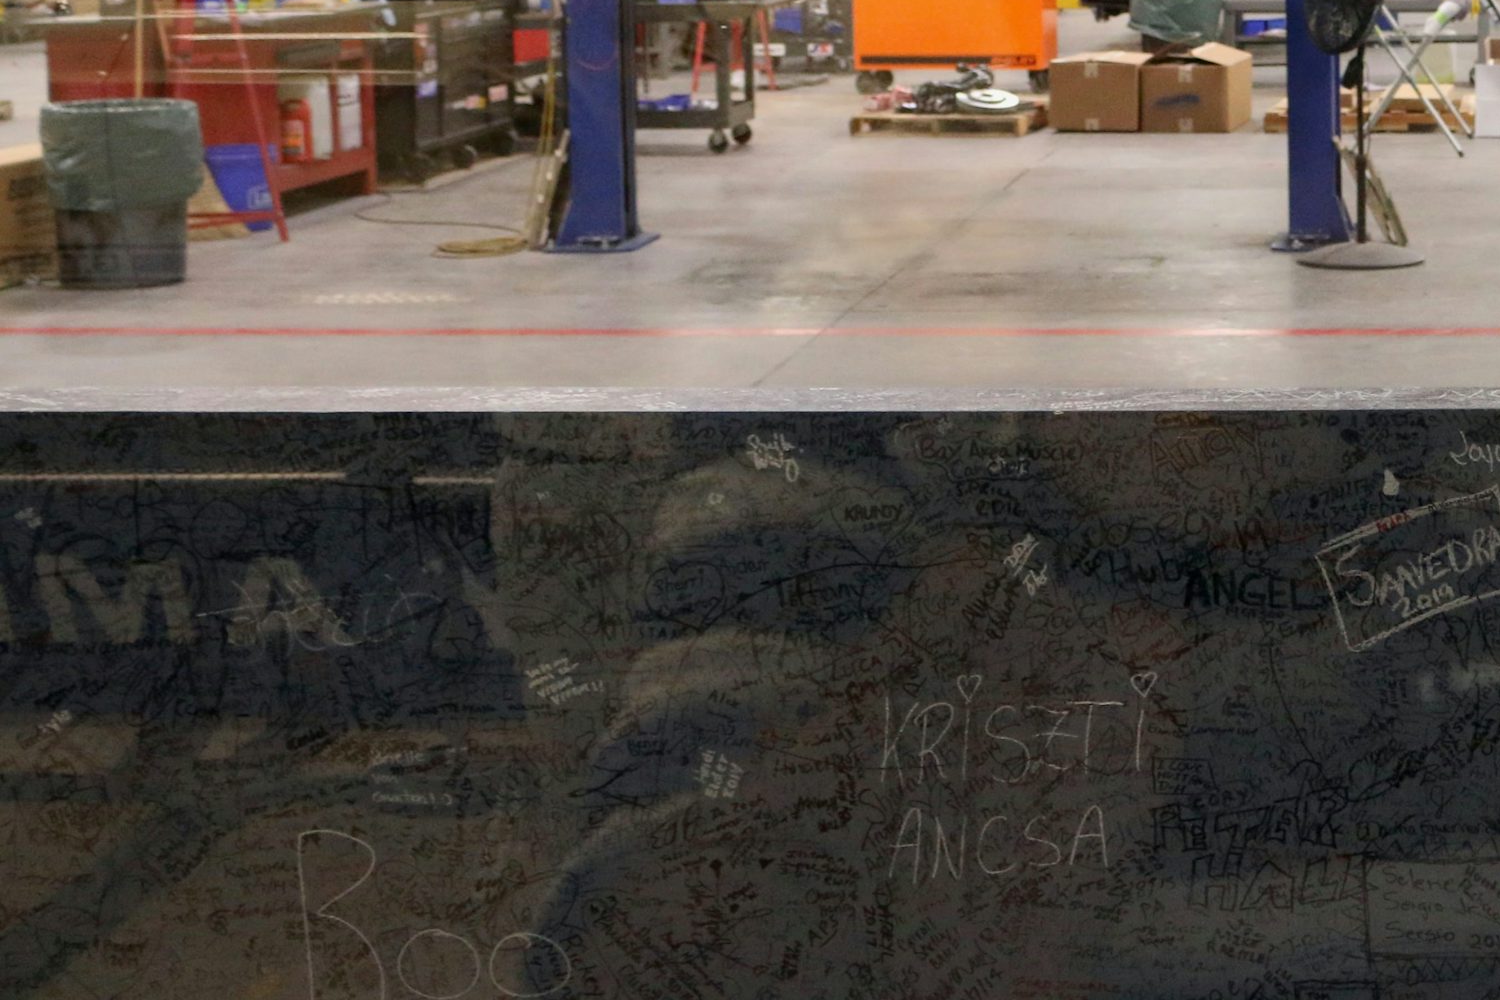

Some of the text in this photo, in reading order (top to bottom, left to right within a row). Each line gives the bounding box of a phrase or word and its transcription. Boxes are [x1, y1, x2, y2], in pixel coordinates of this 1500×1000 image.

[1183, 568, 1324, 609] ANGEL
[1391, 582, 1454, 618] 2019
[889, 804, 1109, 886] ANCSA
